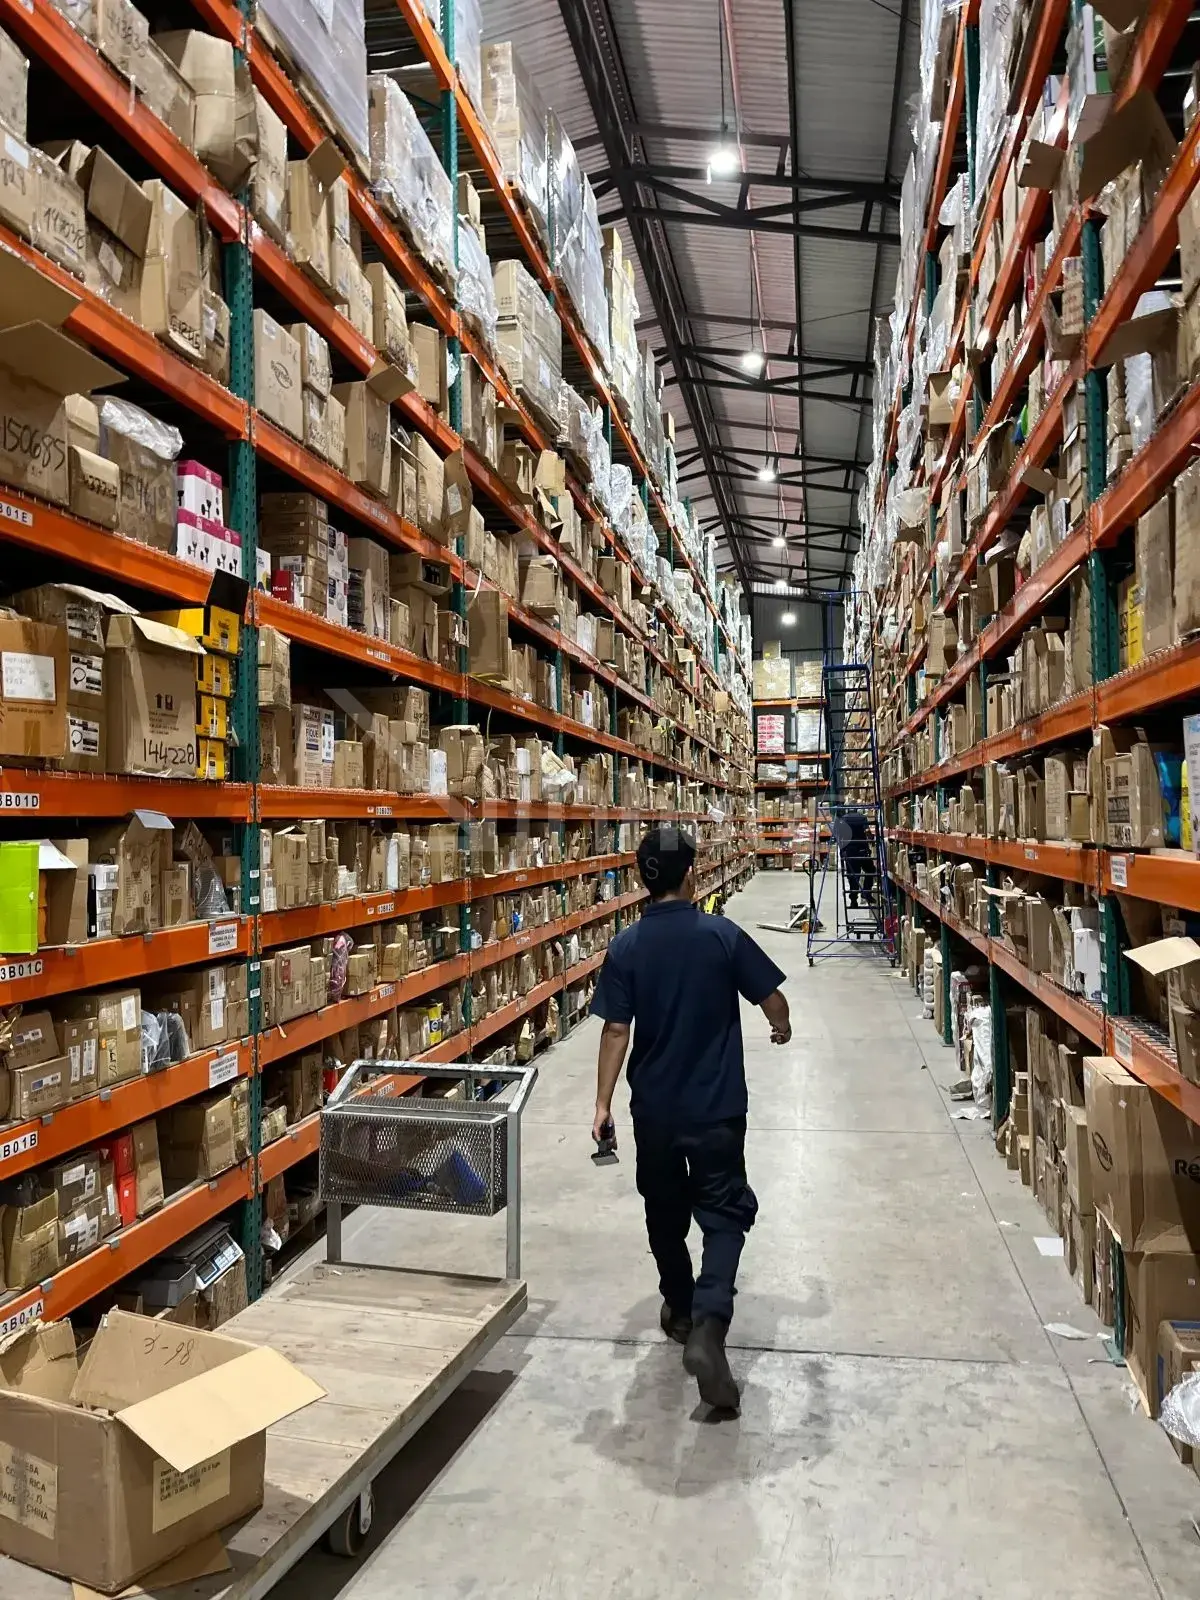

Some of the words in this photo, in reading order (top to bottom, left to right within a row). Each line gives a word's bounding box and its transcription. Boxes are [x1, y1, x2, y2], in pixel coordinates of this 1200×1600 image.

[143, 738, 195, 766] 144228
[1, 961, 42, 980] 3B01C
[2, 1302, 43, 1335] 3B01A
[29, 1478, 46, 1493] RICA
